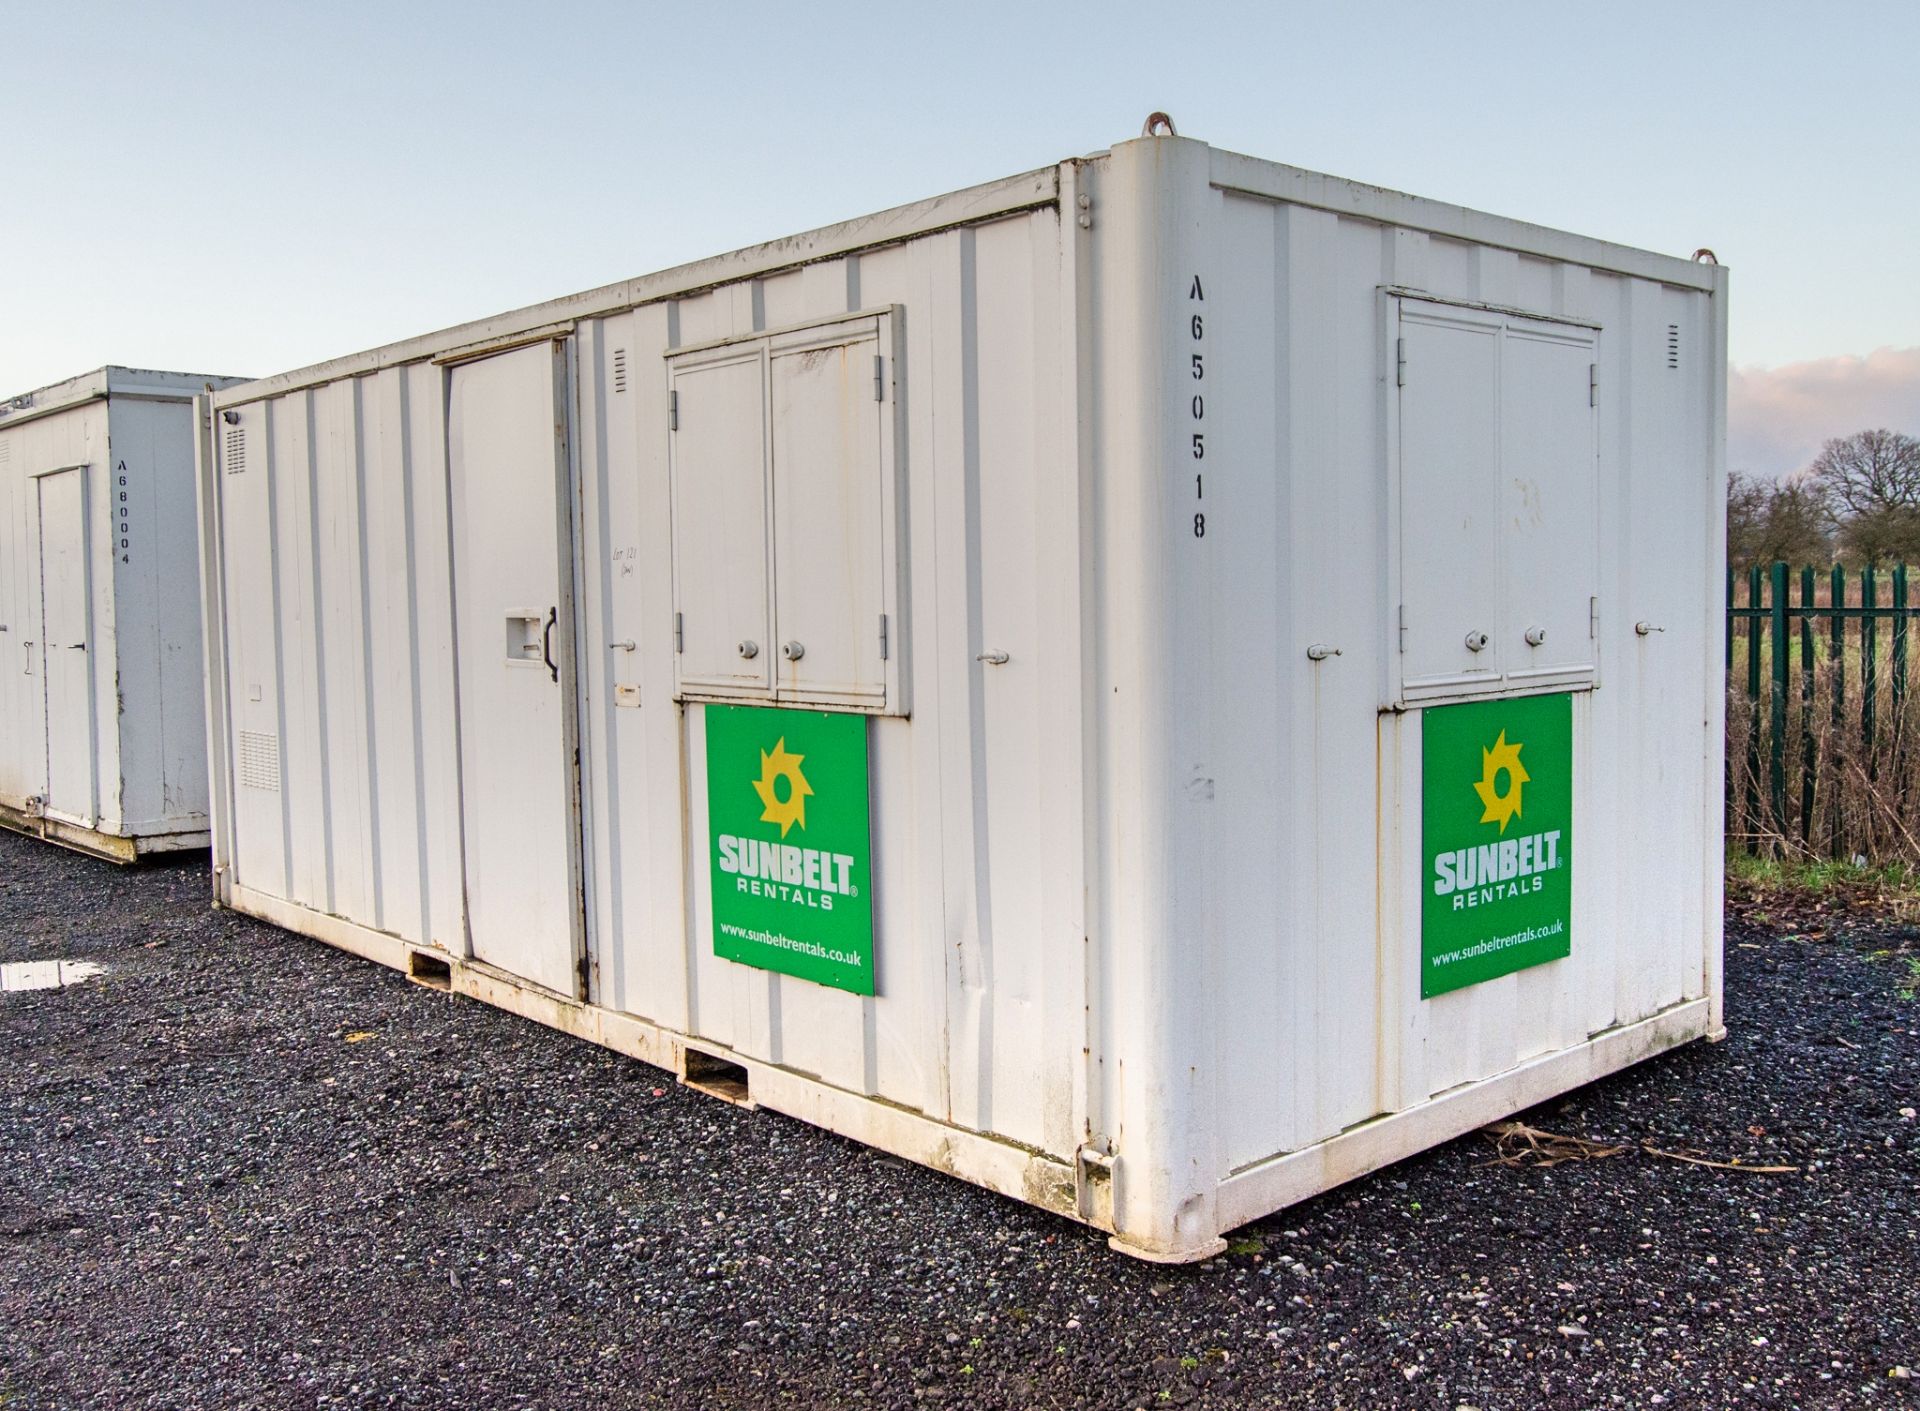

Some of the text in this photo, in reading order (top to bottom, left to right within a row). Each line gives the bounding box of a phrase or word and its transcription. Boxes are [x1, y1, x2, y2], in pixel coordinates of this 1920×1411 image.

[1190, 274, 1205, 538] A650518
[118, 460, 129, 564] A680004
[718, 833, 854, 896] SUNBELT
[1433, 829, 1561, 896] SUNBELT
[737, 877, 833, 910] RENTALS
[1453, 875, 1543, 911] RENTALS
[720, 922, 862, 966] www.sunbeltrentals.co.uk
[1432, 918, 1563, 967] www.sunbeltrentals.co.uk
